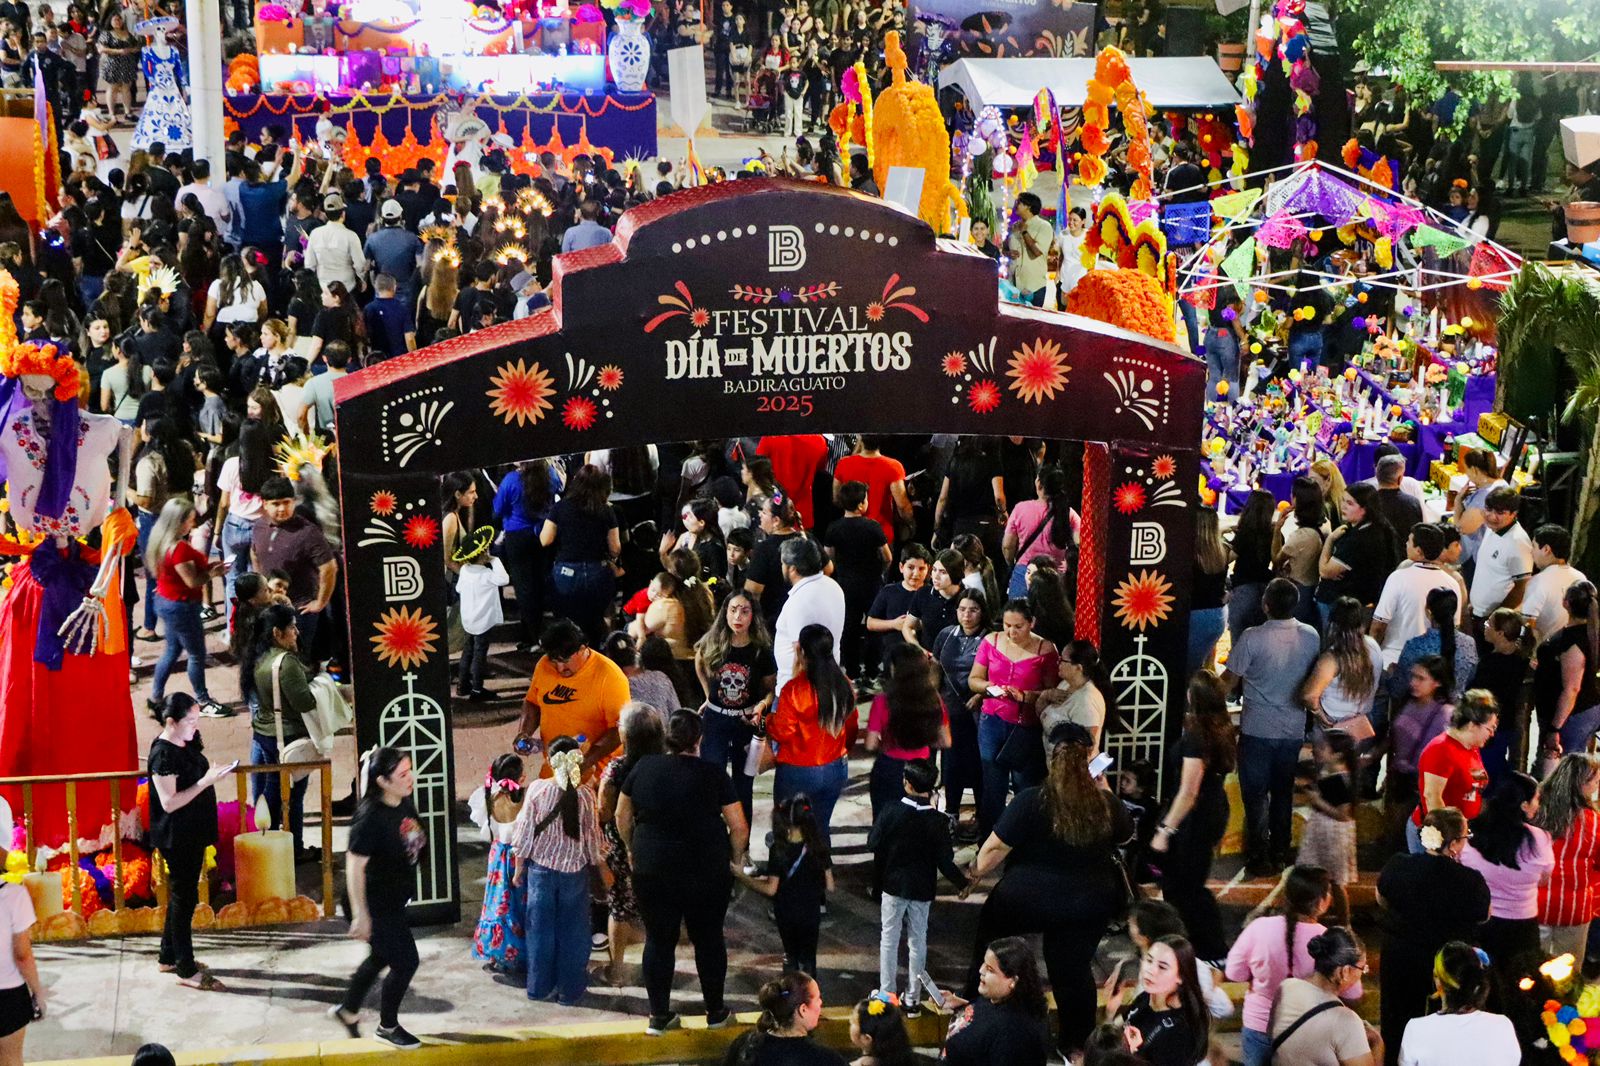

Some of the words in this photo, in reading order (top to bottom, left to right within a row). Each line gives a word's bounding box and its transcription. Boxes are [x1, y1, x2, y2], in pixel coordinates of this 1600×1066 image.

[711, 306, 868, 336] FESTIVAL
[665, 329, 723, 379] DÍA
[727, 351, 745, 363] DE
[751, 331, 913, 377] MUERTOS
[723, 376, 846, 394] BADIRAGUATO
[756, 395, 814, 417] 2025
[550, 684, 577, 699] NIKE
